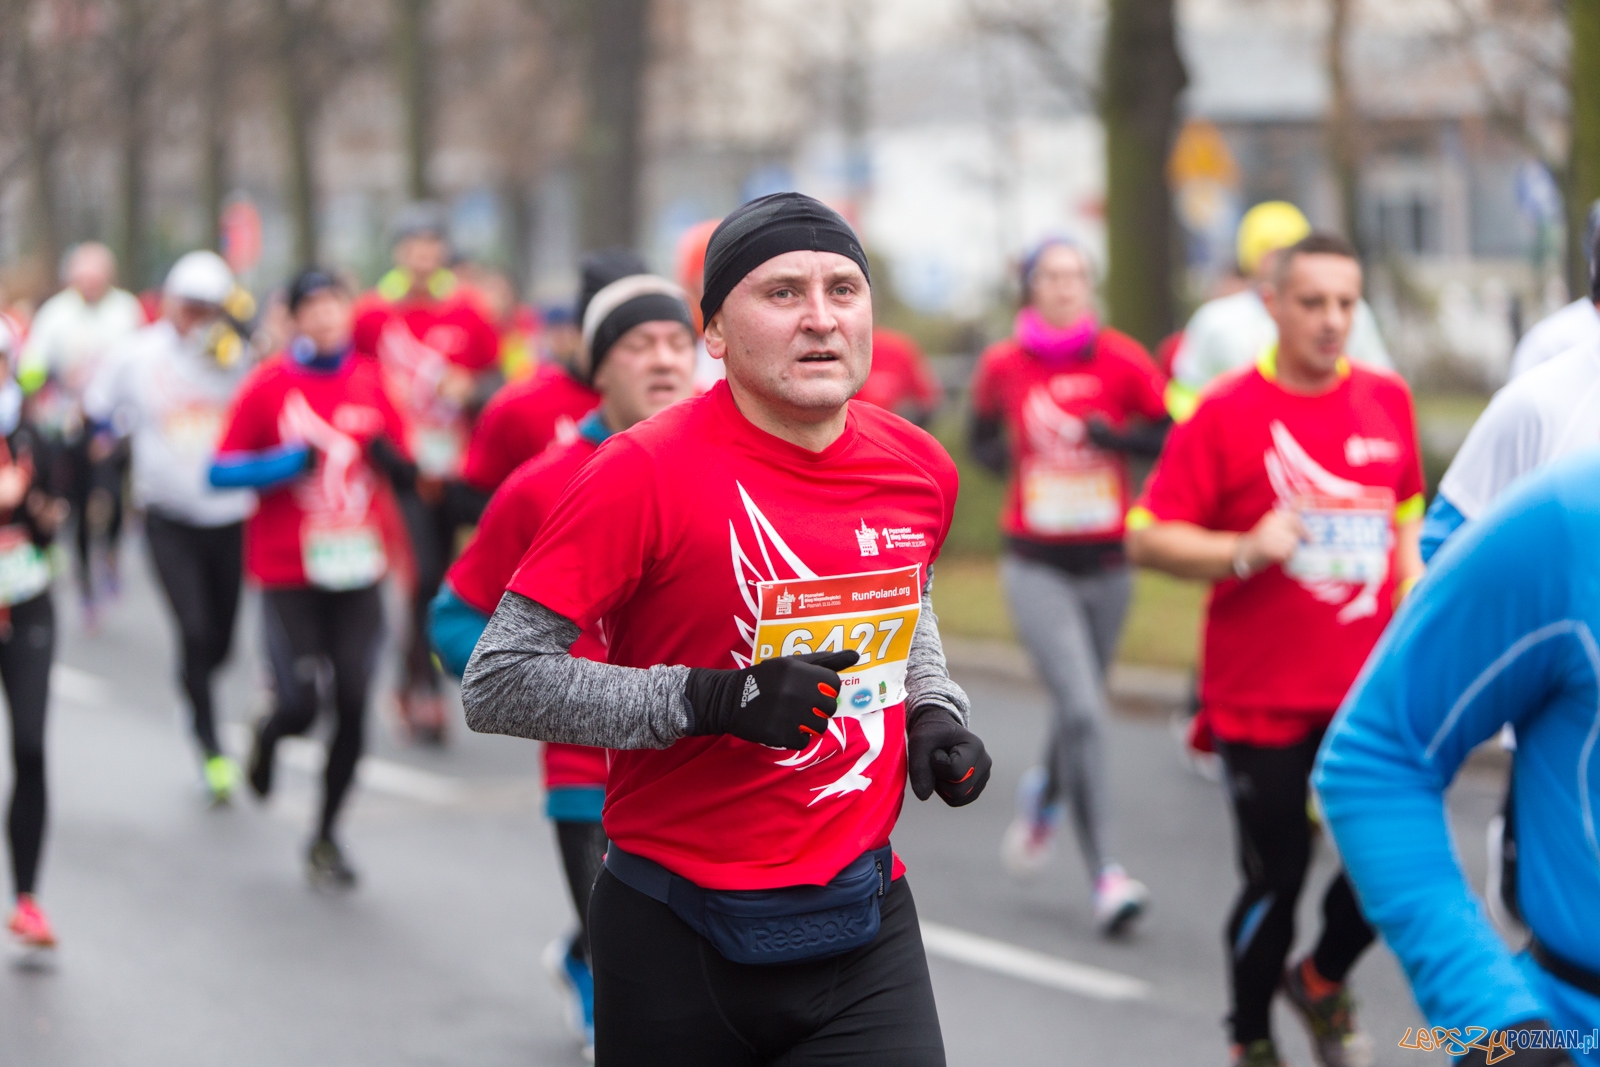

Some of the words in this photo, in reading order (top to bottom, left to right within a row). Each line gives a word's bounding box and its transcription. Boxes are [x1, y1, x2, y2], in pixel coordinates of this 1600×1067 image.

[882, 528, 894, 548] 1
[798, 593, 806, 609] 1
[851, 586, 910, 602] RunPoland.org
[780, 617, 904, 666] 6427
[759, 644, 774, 658] D
[840, 676, 860, 686] rcin
[740, 674, 753, 708] adidas
[751, 914, 858, 952] Reebok
